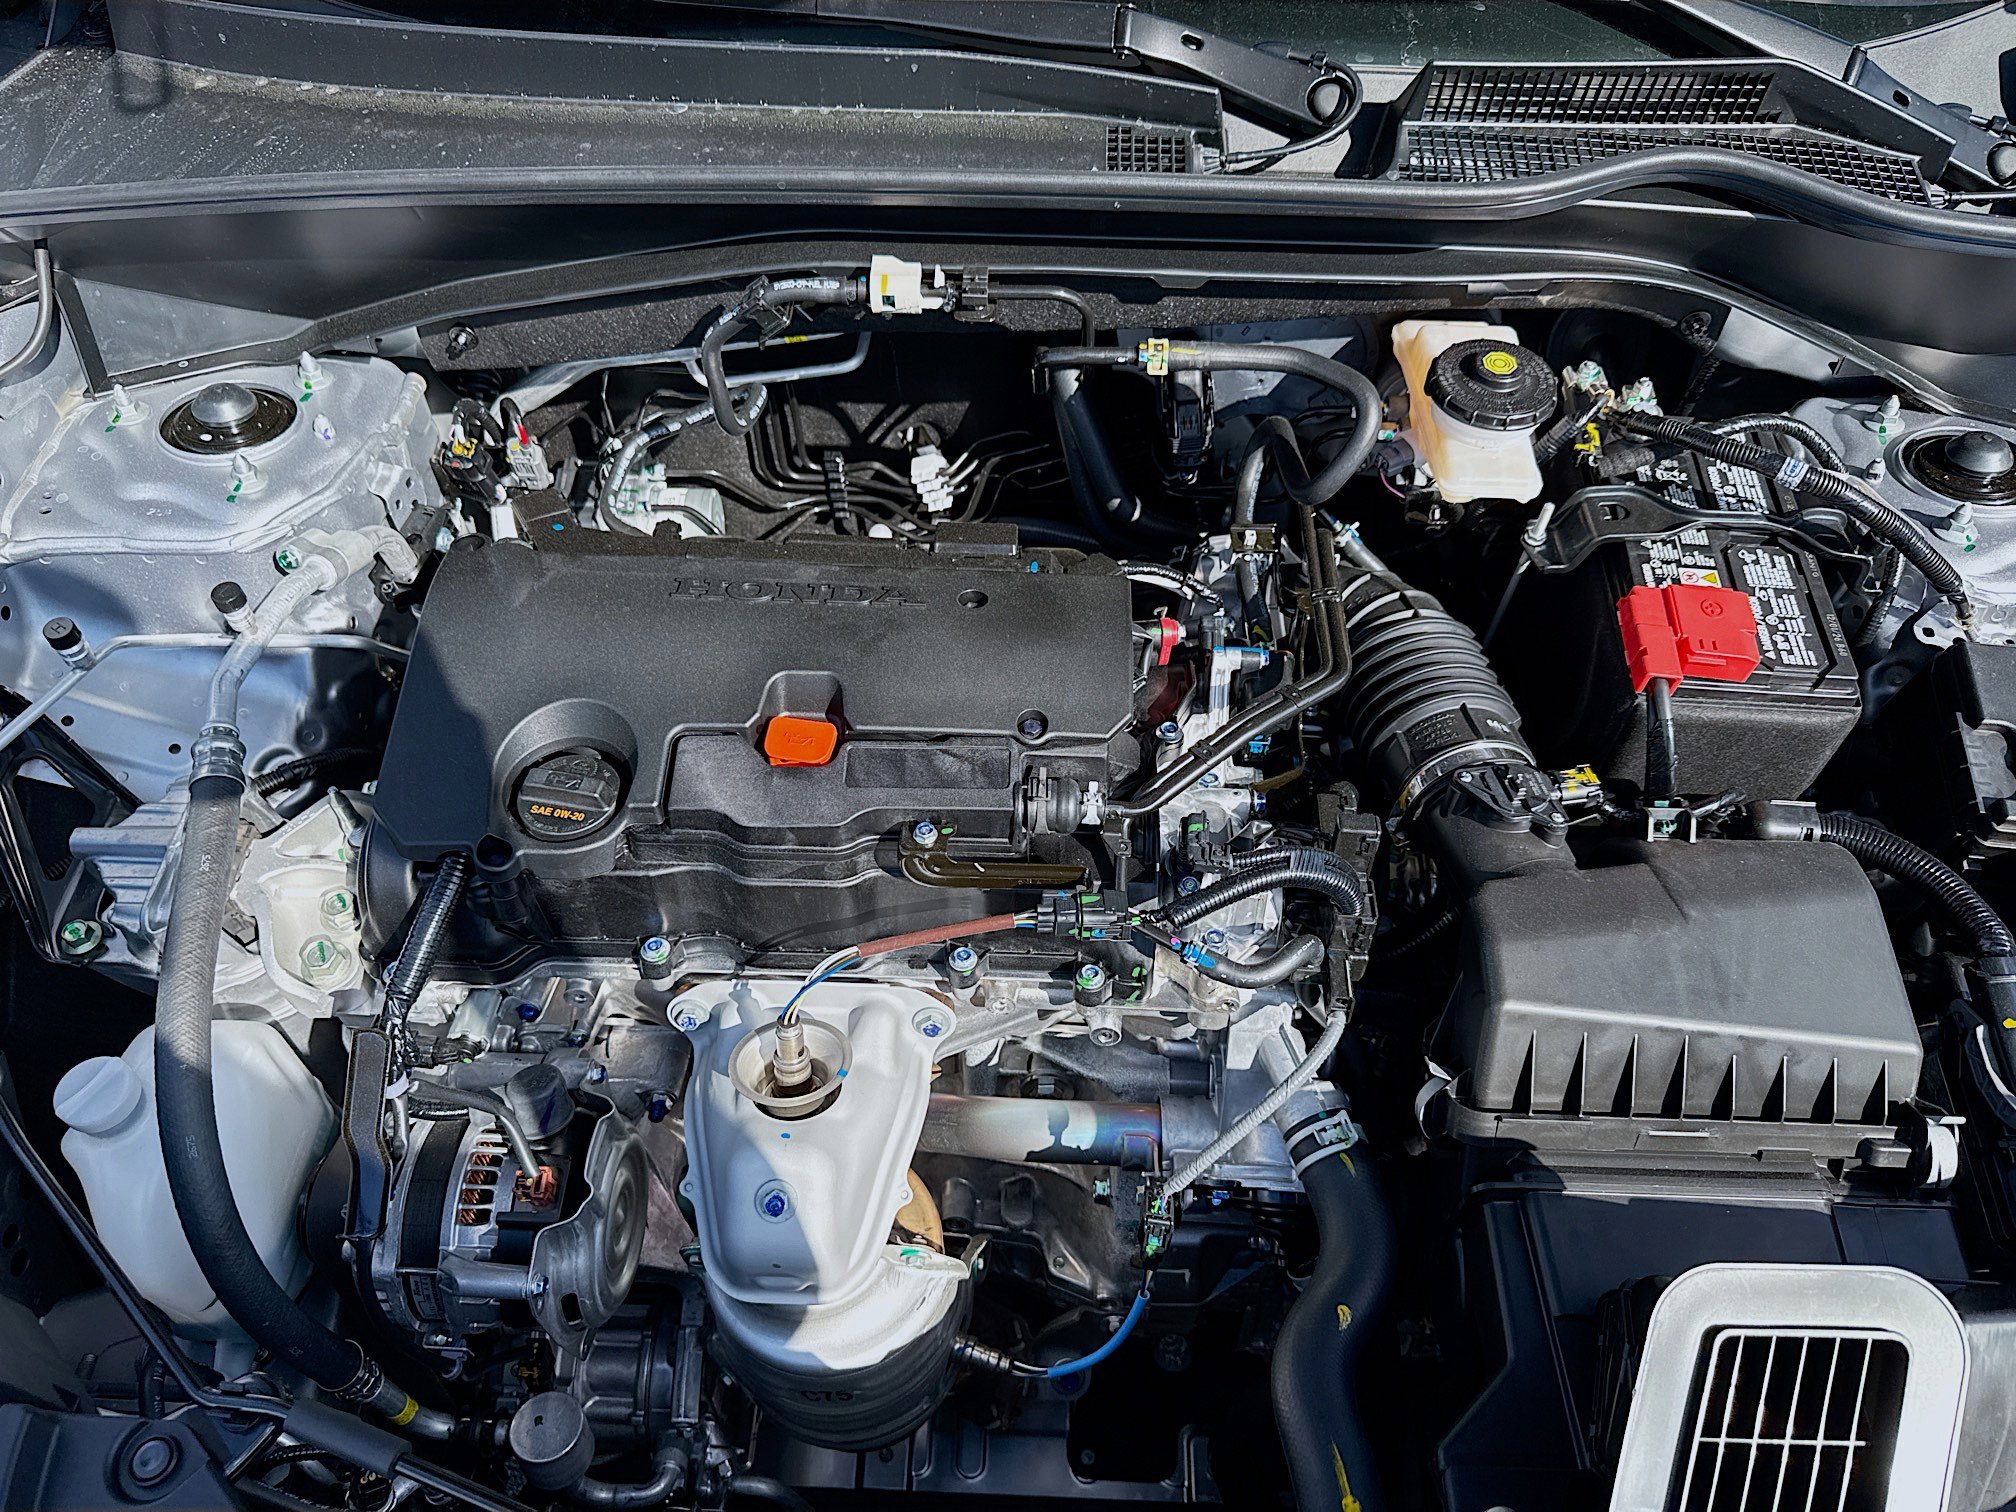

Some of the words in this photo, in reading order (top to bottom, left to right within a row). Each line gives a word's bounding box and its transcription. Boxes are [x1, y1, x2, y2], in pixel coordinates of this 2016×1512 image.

[668, 577, 927, 608] HONDA
[50, 622, 67, 634] H
[530, 805, 554, 817] SAE
[553, 808, 585, 822] 0W-20
